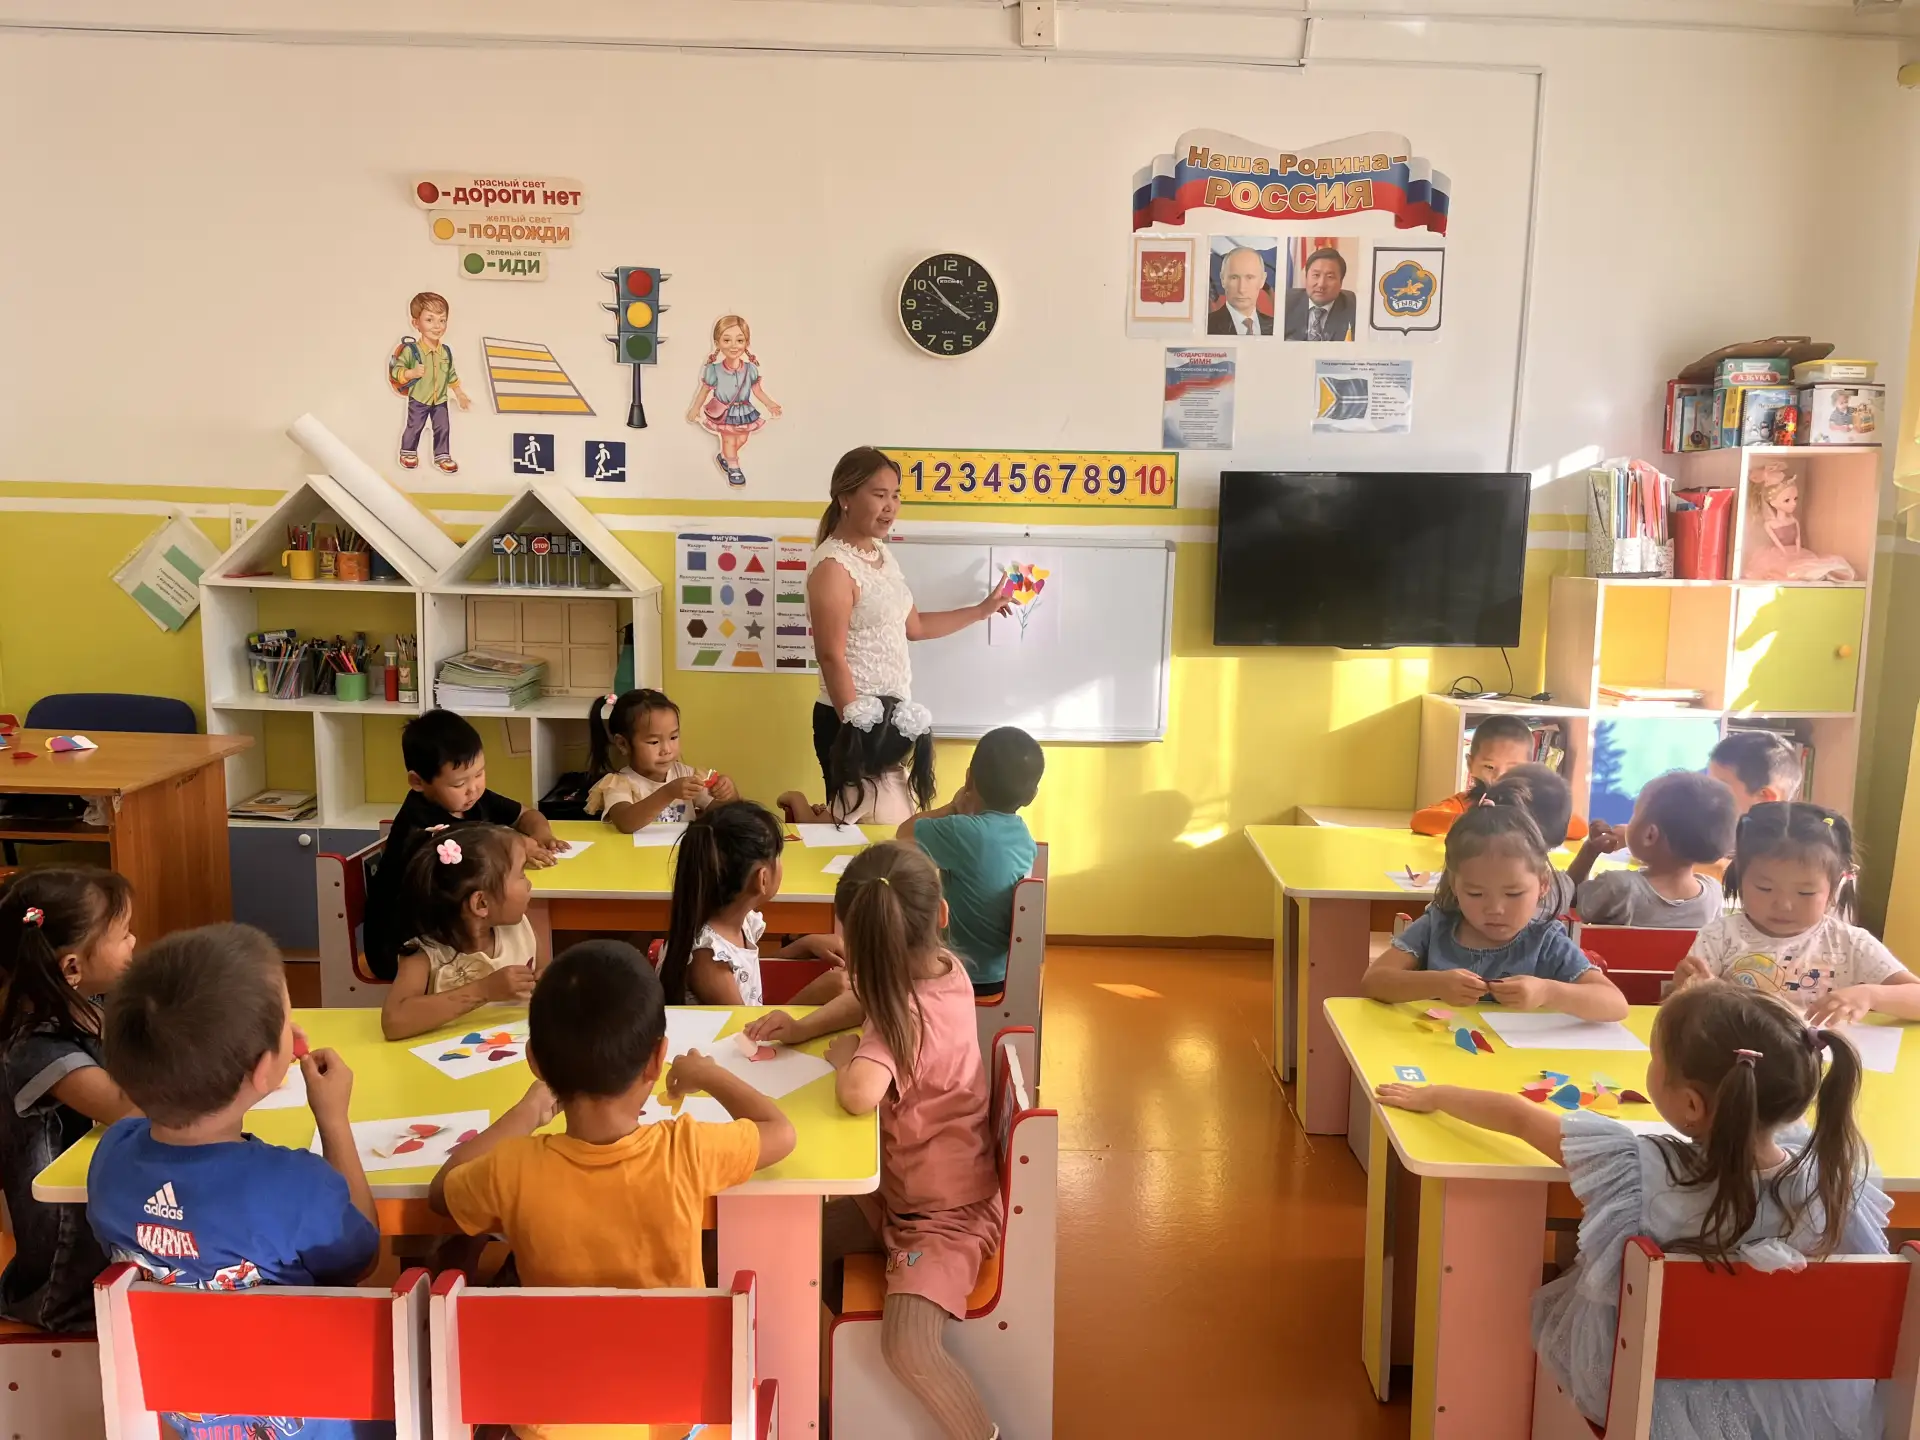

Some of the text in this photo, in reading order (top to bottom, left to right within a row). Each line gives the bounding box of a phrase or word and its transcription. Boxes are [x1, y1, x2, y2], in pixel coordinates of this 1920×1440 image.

[1187, 146, 1269, 175] Наша
[473, 178, 546, 188] красный свет
[542, 190, 582, 206] нет
[1204, 177, 1374, 213] РОССИЯ
[529, 215, 552, 224] свет
[928, 265, 937, 277] 11
[944, 259, 958, 271] 12
[913, 279, 927, 291] 10
[977, 280, 988, 292] 2
[906, 298, 917, 310] 9
[983, 301, 994, 313] 3
[911, 319, 923, 331] 8
[975, 320, 987, 332] 4
[926, 334, 937, 346] 7
[942, 339, 954, 351] 6
[962, 335, 973, 347] 5
[1738, 374, 1771, 382] АЗБУКА
[910, 461, 1167, 495] 1 2 3 4 5 6 7 8 9 10
[1401, 1069, 1420, 1080] 15
[143, 1203, 184, 1221] adidas
[137, 1225, 199, 1259] MARVEL
